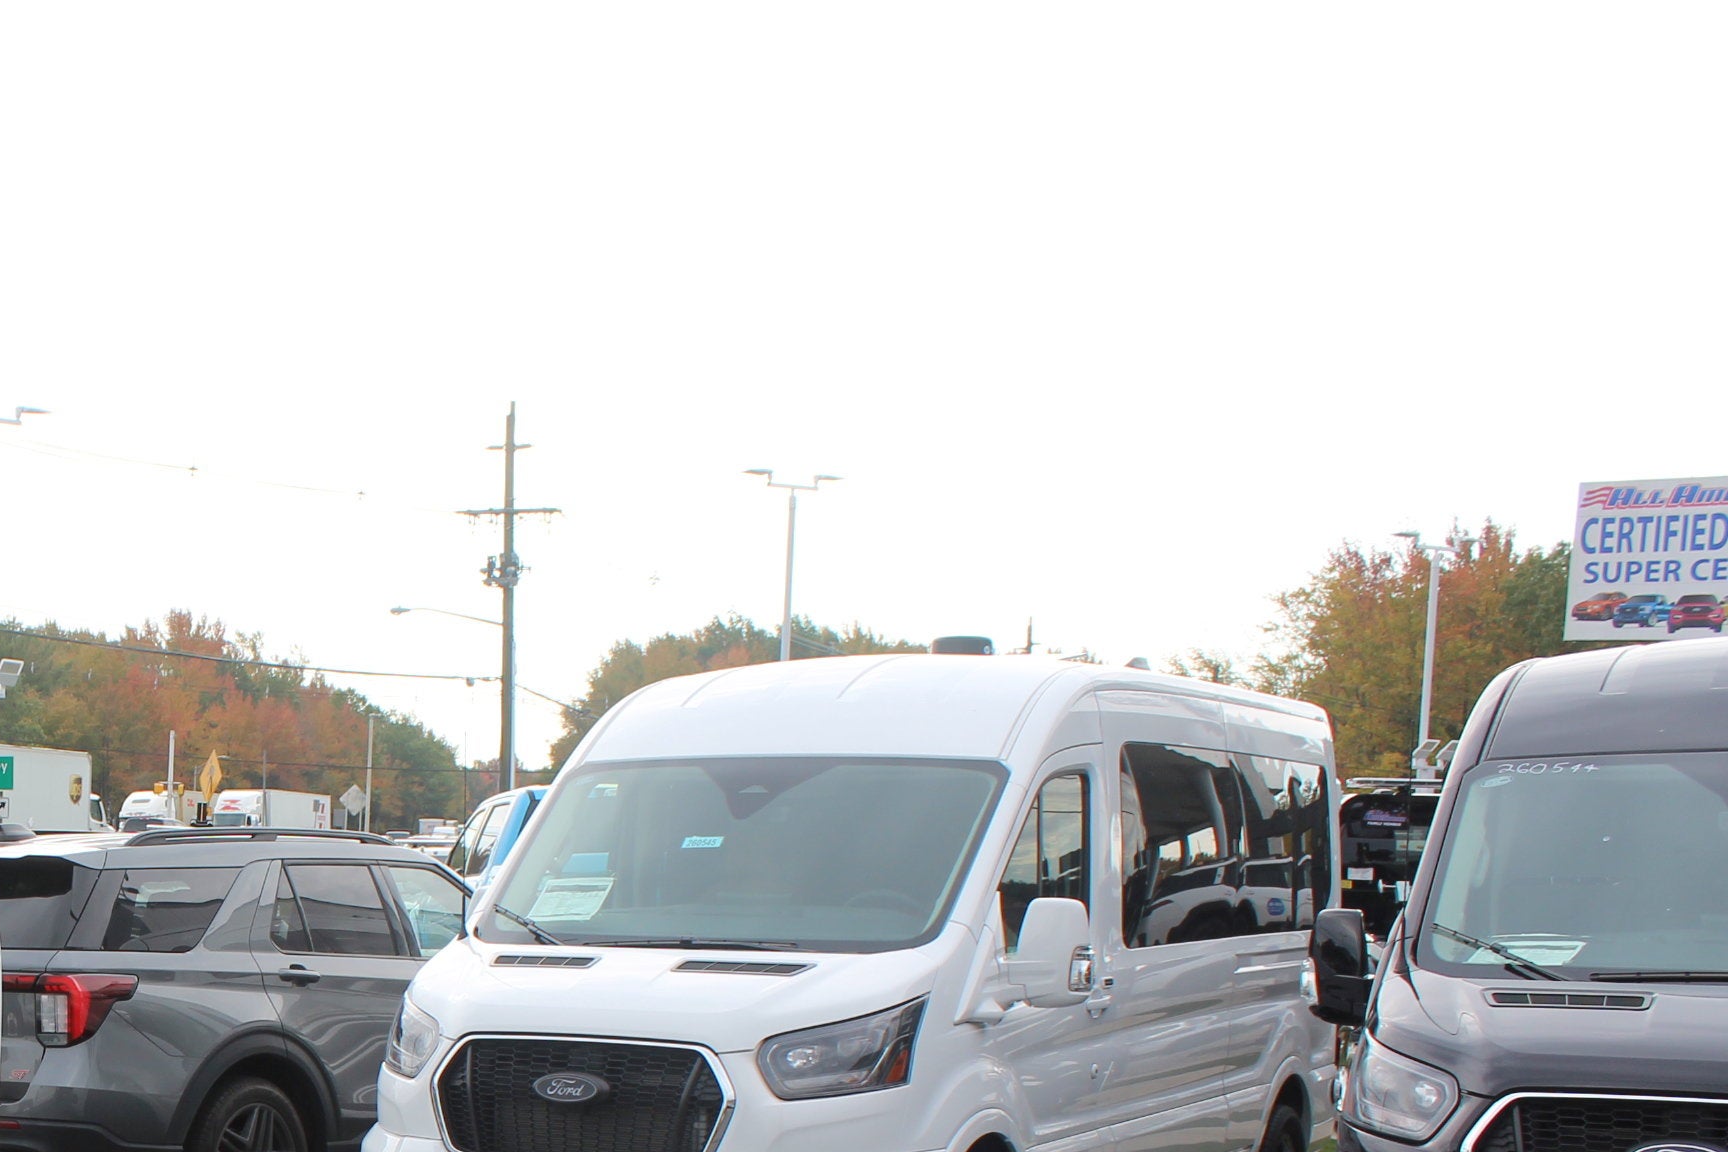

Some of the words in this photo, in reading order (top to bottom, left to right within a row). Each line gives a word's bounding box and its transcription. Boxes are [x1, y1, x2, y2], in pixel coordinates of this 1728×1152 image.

[1581, 513, 1728, 554] CERTIFIED
[1583, 559, 1681, 584] SUPER
[546, 1078, 585, 1097] Ford
